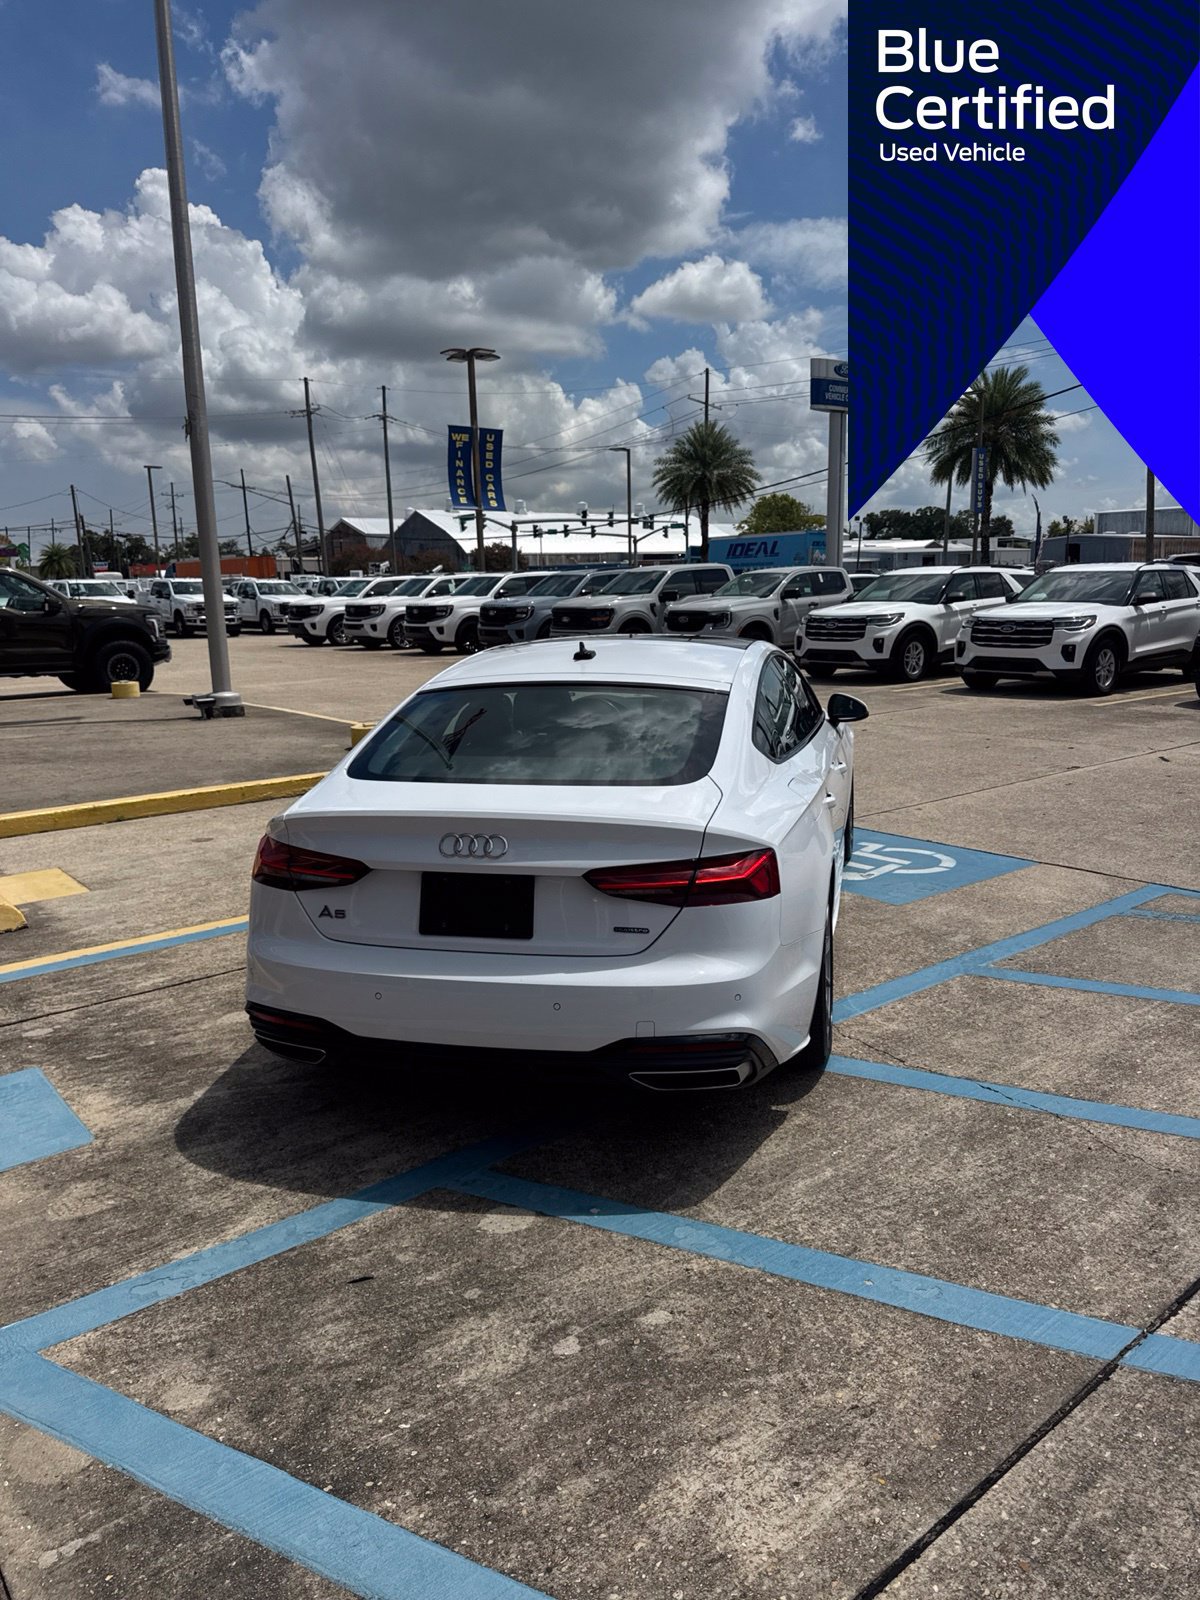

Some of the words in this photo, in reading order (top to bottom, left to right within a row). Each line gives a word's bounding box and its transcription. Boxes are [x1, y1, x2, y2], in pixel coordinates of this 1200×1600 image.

[451, 433, 469, 441] WE
[485, 433, 495, 468] USED
[455, 441, 468, 504] FINANCE
[485, 474, 498, 507] CARS
[726, 540, 780, 558] IDEAL
[318, 904, 347, 919] A5
